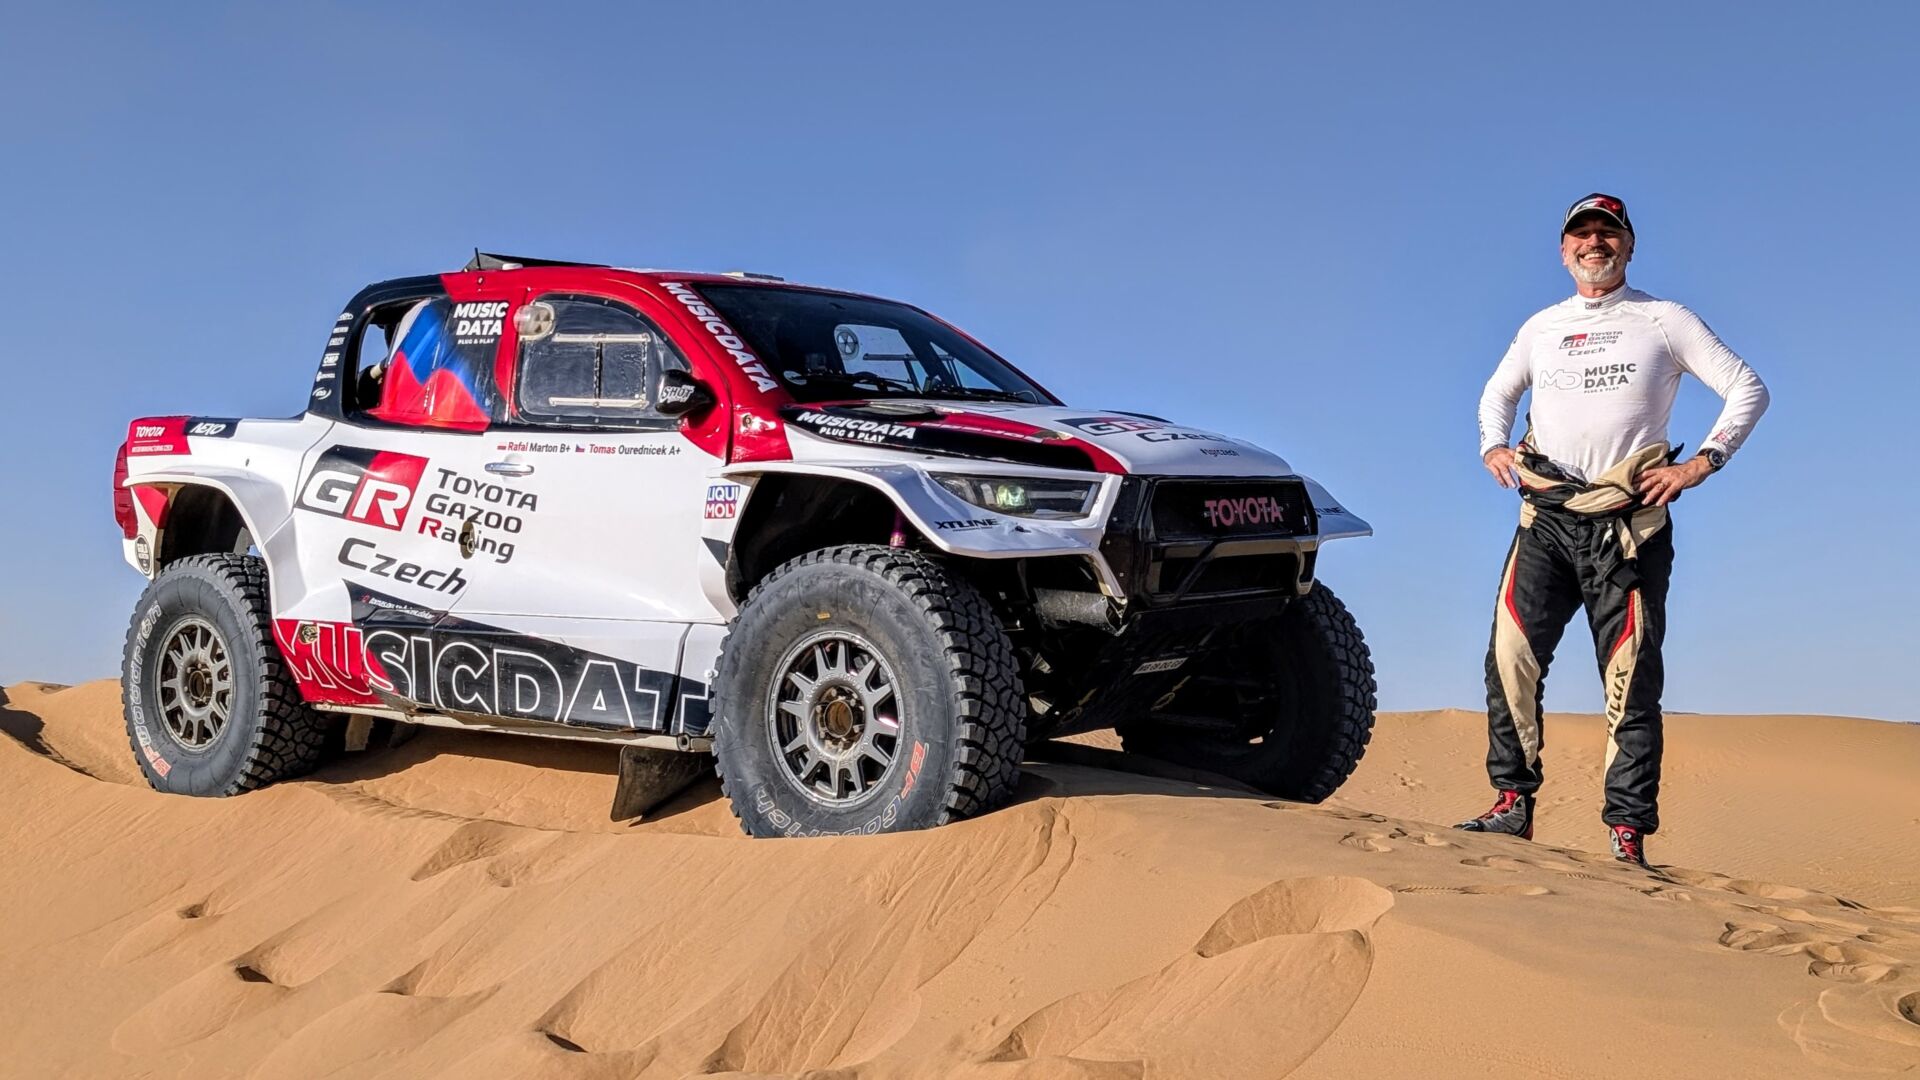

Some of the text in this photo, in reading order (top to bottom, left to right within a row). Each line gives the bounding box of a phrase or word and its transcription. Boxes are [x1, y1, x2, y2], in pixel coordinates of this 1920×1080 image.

[453, 302, 509, 318] MUSIC
[456, 320, 502, 335] DATA
[659, 282, 778, 393] MUSICDATA
[1568, 347, 1606, 356] Czech
[1584, 363, 1637, 377] MUSIC
[1584, 375, 1629, 389] DATA
[136, 426, 165, 438] TOYOTA
[797, 411, 916, 439] MUSICDATA
[820, 427, 846, 437] PLUG
[857, 433, 885, 443] PLAY
[529, 443, 558, 453] Marton
[559, 444, 571, 453] B+
[589, 444, 616, 454] Tomas
[618, 445, 667, 455] Ourednicek
[668, 446, 681, 455] A+
[437, 468, 538, 512] TOYOTA
[302, 470, 411, 527] GR
[425, 494, 523, 534] GAZOO
[705, 503, 736, 517] MOLY
[1204, 497, 1284, 527] TOYOTA
[934, 518, 998, 529] XTLINE
[338, 537, 467, 595] Czech
